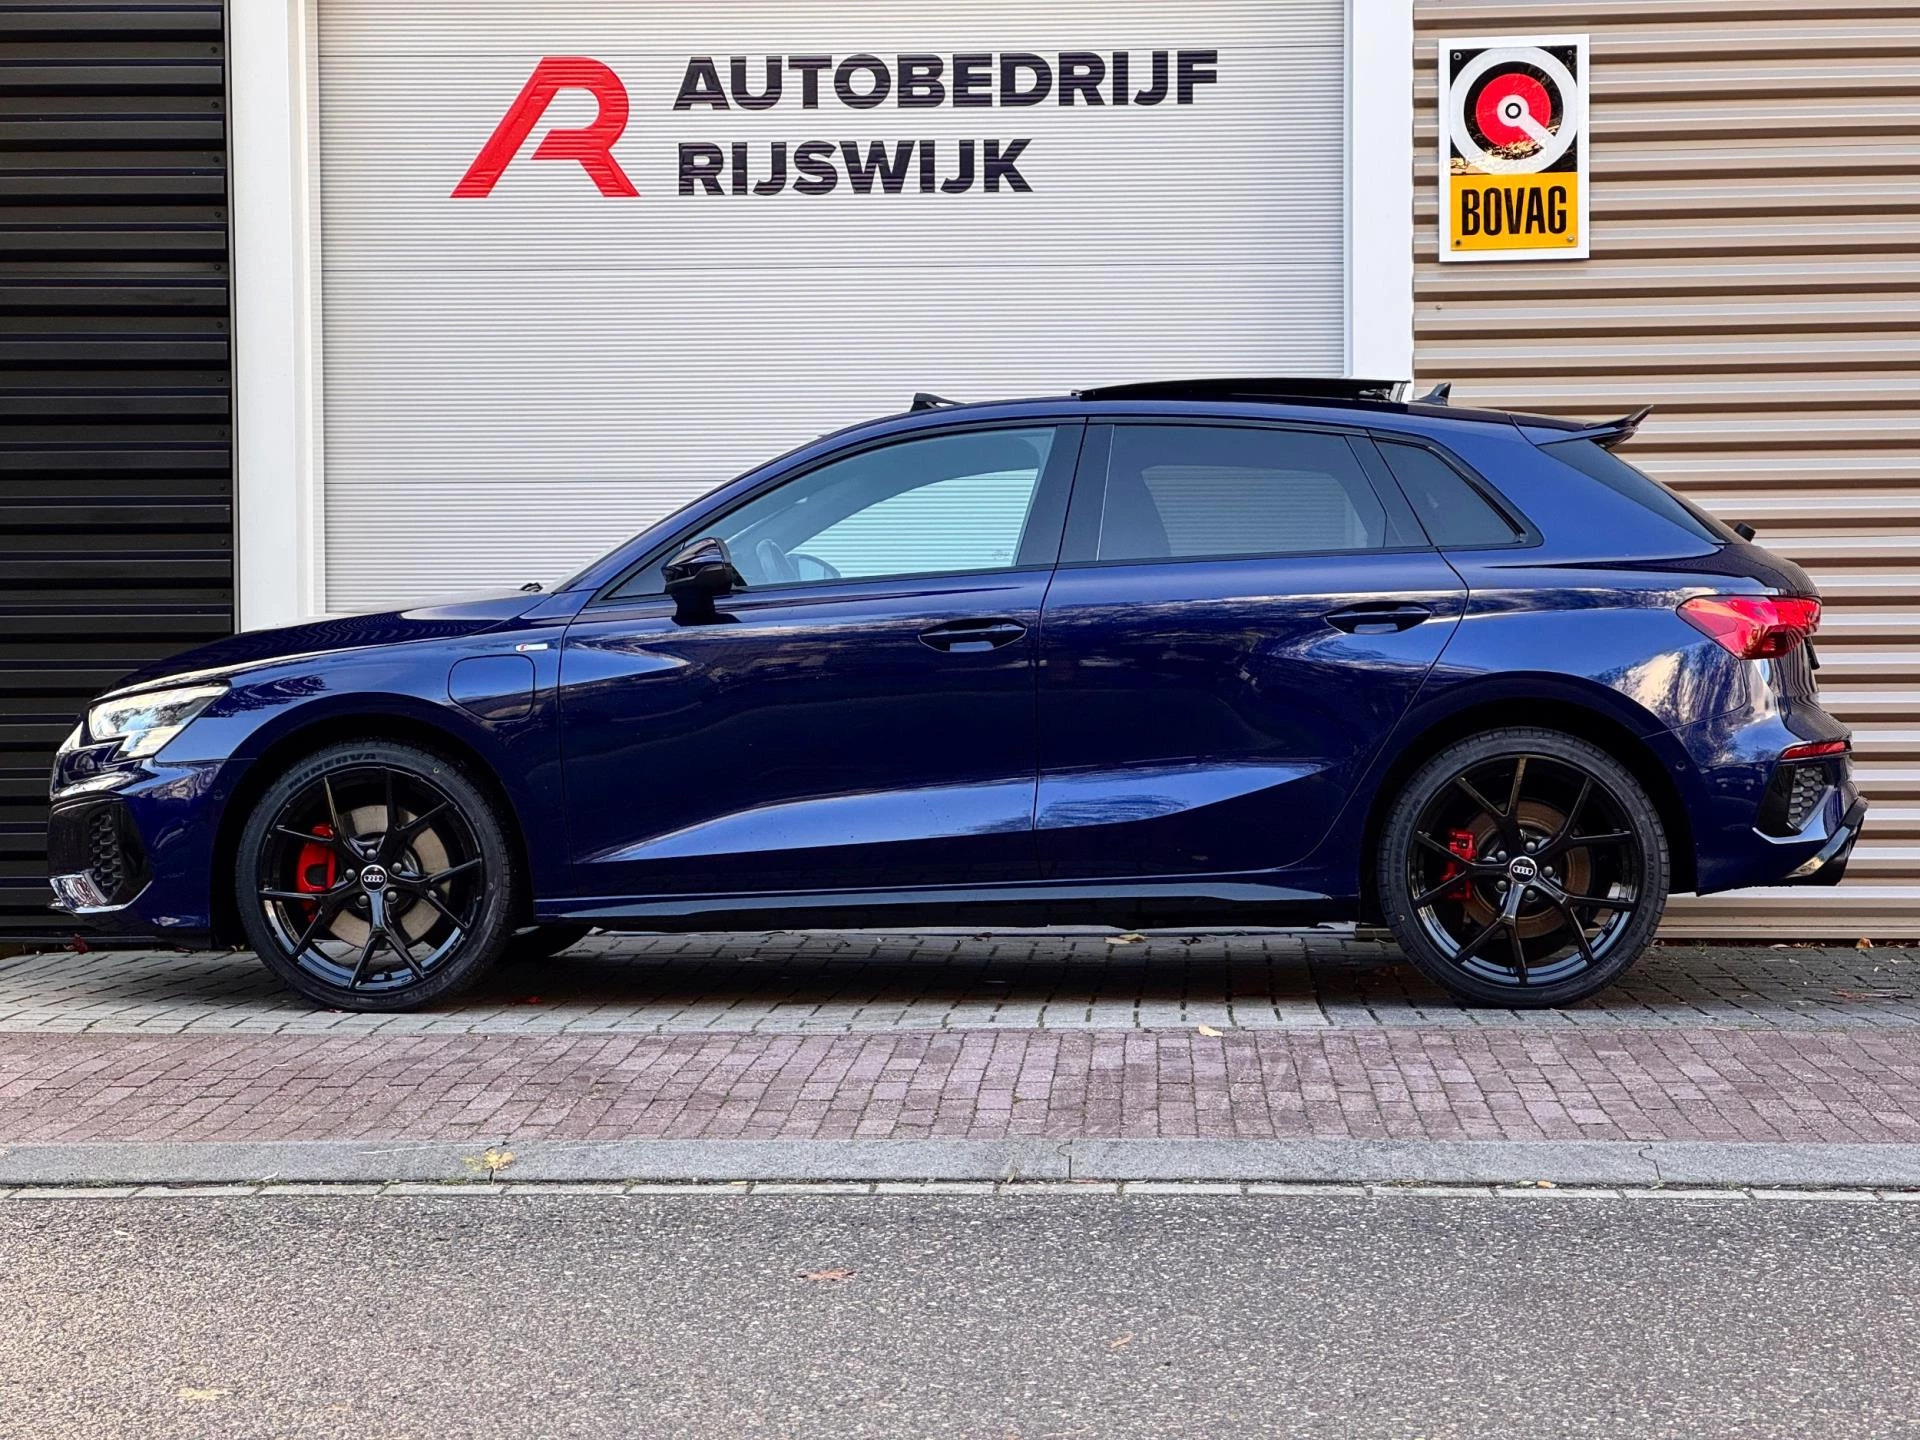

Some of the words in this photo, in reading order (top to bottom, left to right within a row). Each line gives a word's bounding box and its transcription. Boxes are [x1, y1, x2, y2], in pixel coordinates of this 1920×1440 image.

[673, 50, 1218, 111] AUTOBEDRIJF
[678, 138, 1033, 196] RIJSWIJK
[1461, 185, 1567, 236] BOVAG
